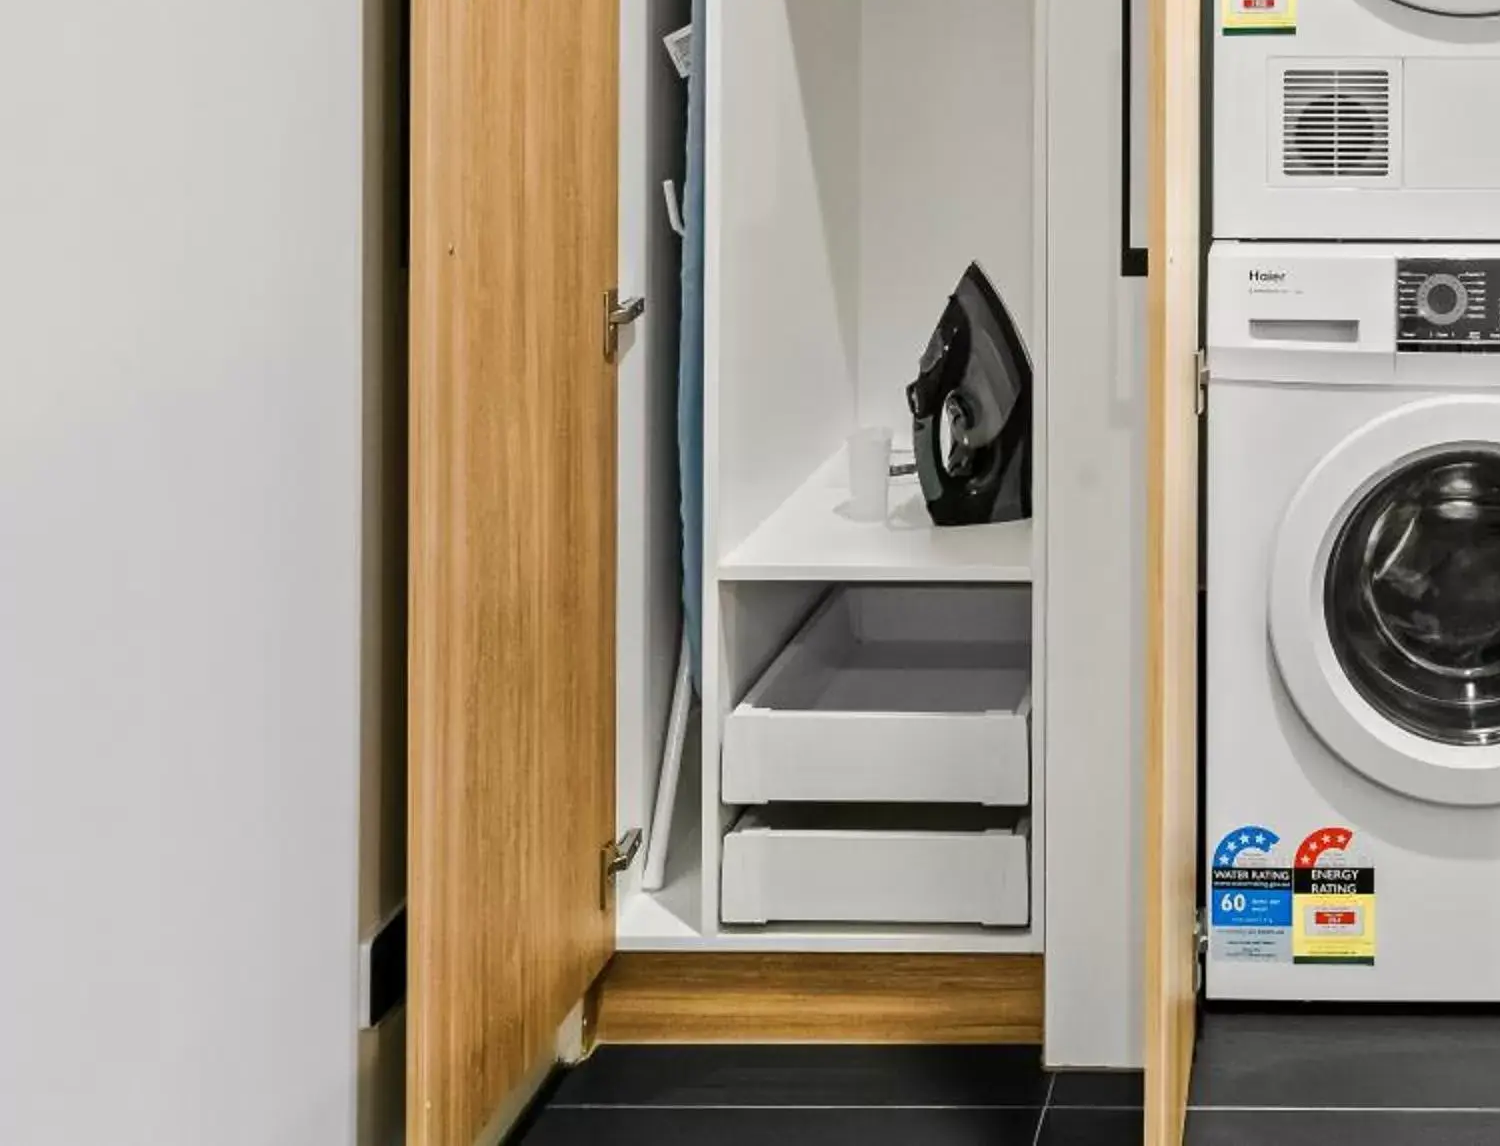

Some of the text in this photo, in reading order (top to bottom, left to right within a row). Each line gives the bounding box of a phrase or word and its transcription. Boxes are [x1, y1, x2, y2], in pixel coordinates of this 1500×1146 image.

[1248, 269, 1286, 281] Haier
[1213, 869, 1290, 880] WATER RATING
[1311, 869, 1359, 880] ENERGY
[1311, 883, 1357, 894] RATING
[1221, 893, 1246, 912] 60
